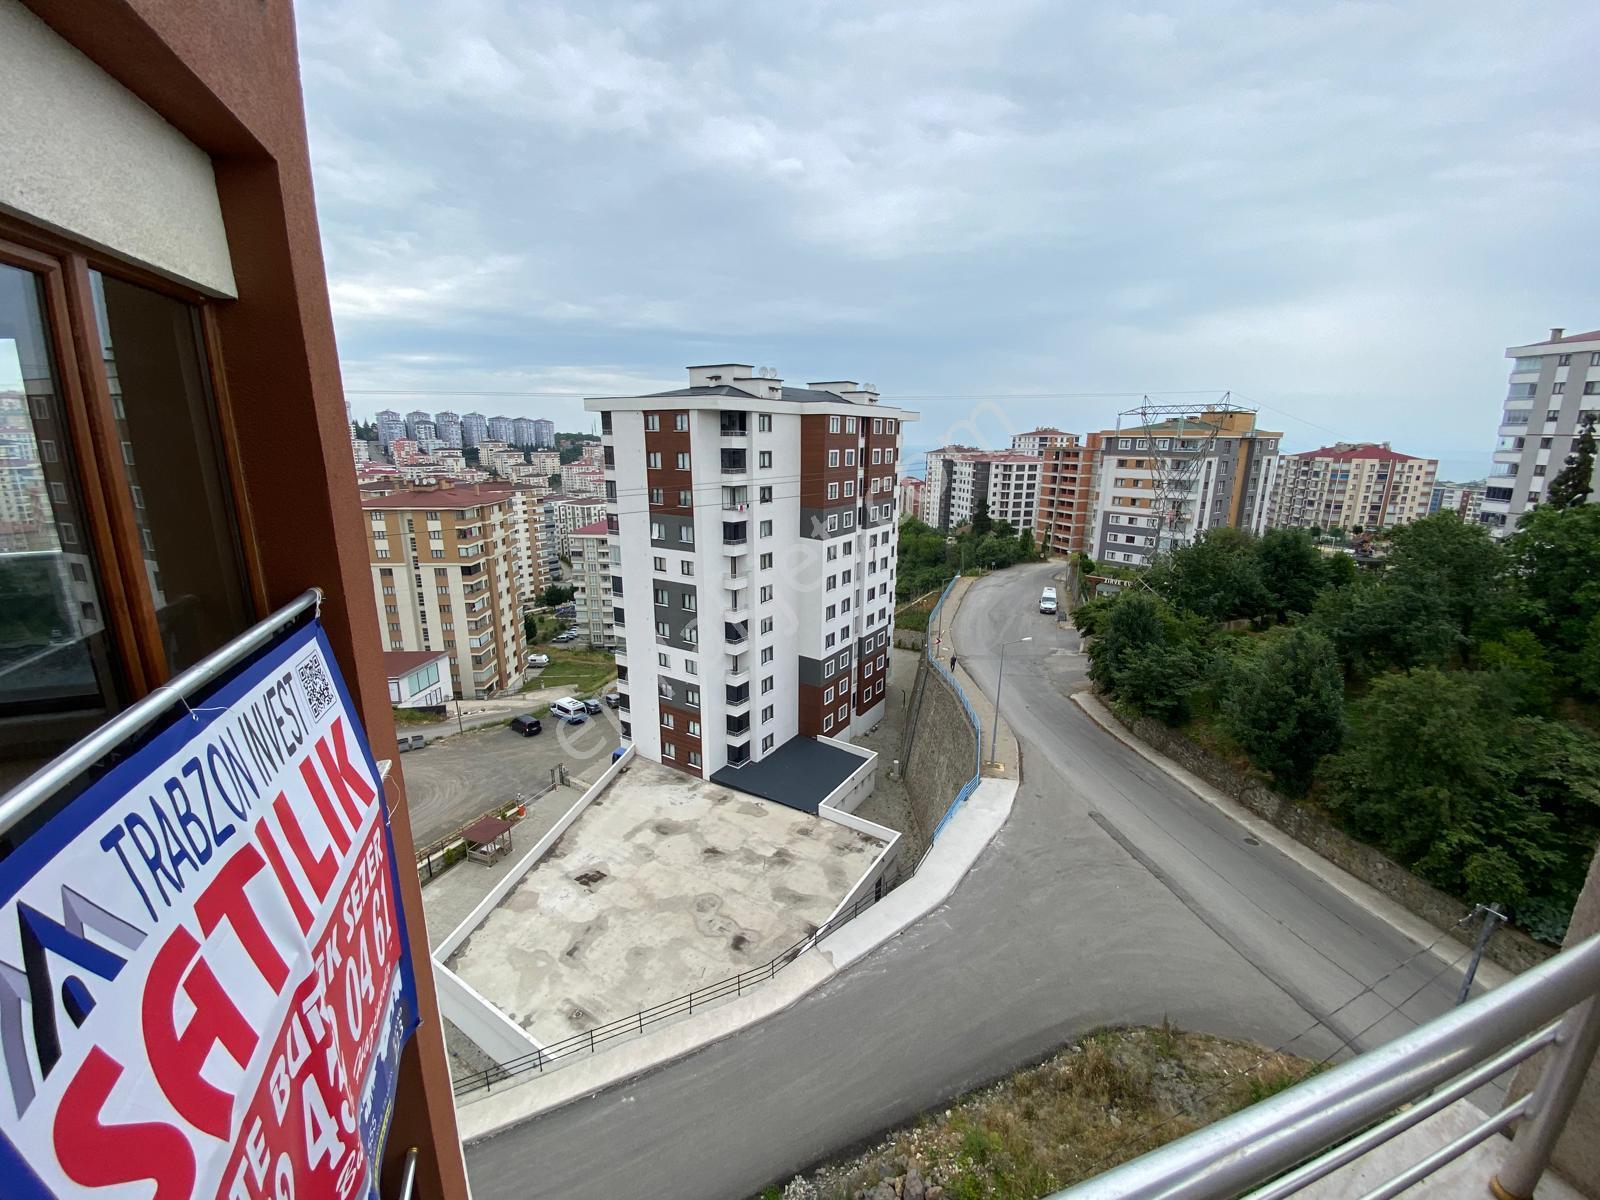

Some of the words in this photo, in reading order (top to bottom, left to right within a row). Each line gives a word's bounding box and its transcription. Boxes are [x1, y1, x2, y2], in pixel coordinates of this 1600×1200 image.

[100, 727, 260, 922] TRABZON
[237, 671, 309, 787] INVEST
[343, 827, 383, 943] SEZER
[53, 716, 376, 1200] SATILIK
[346, 924, 375, 1041] 04
[372, 868, 392, 967] 61
